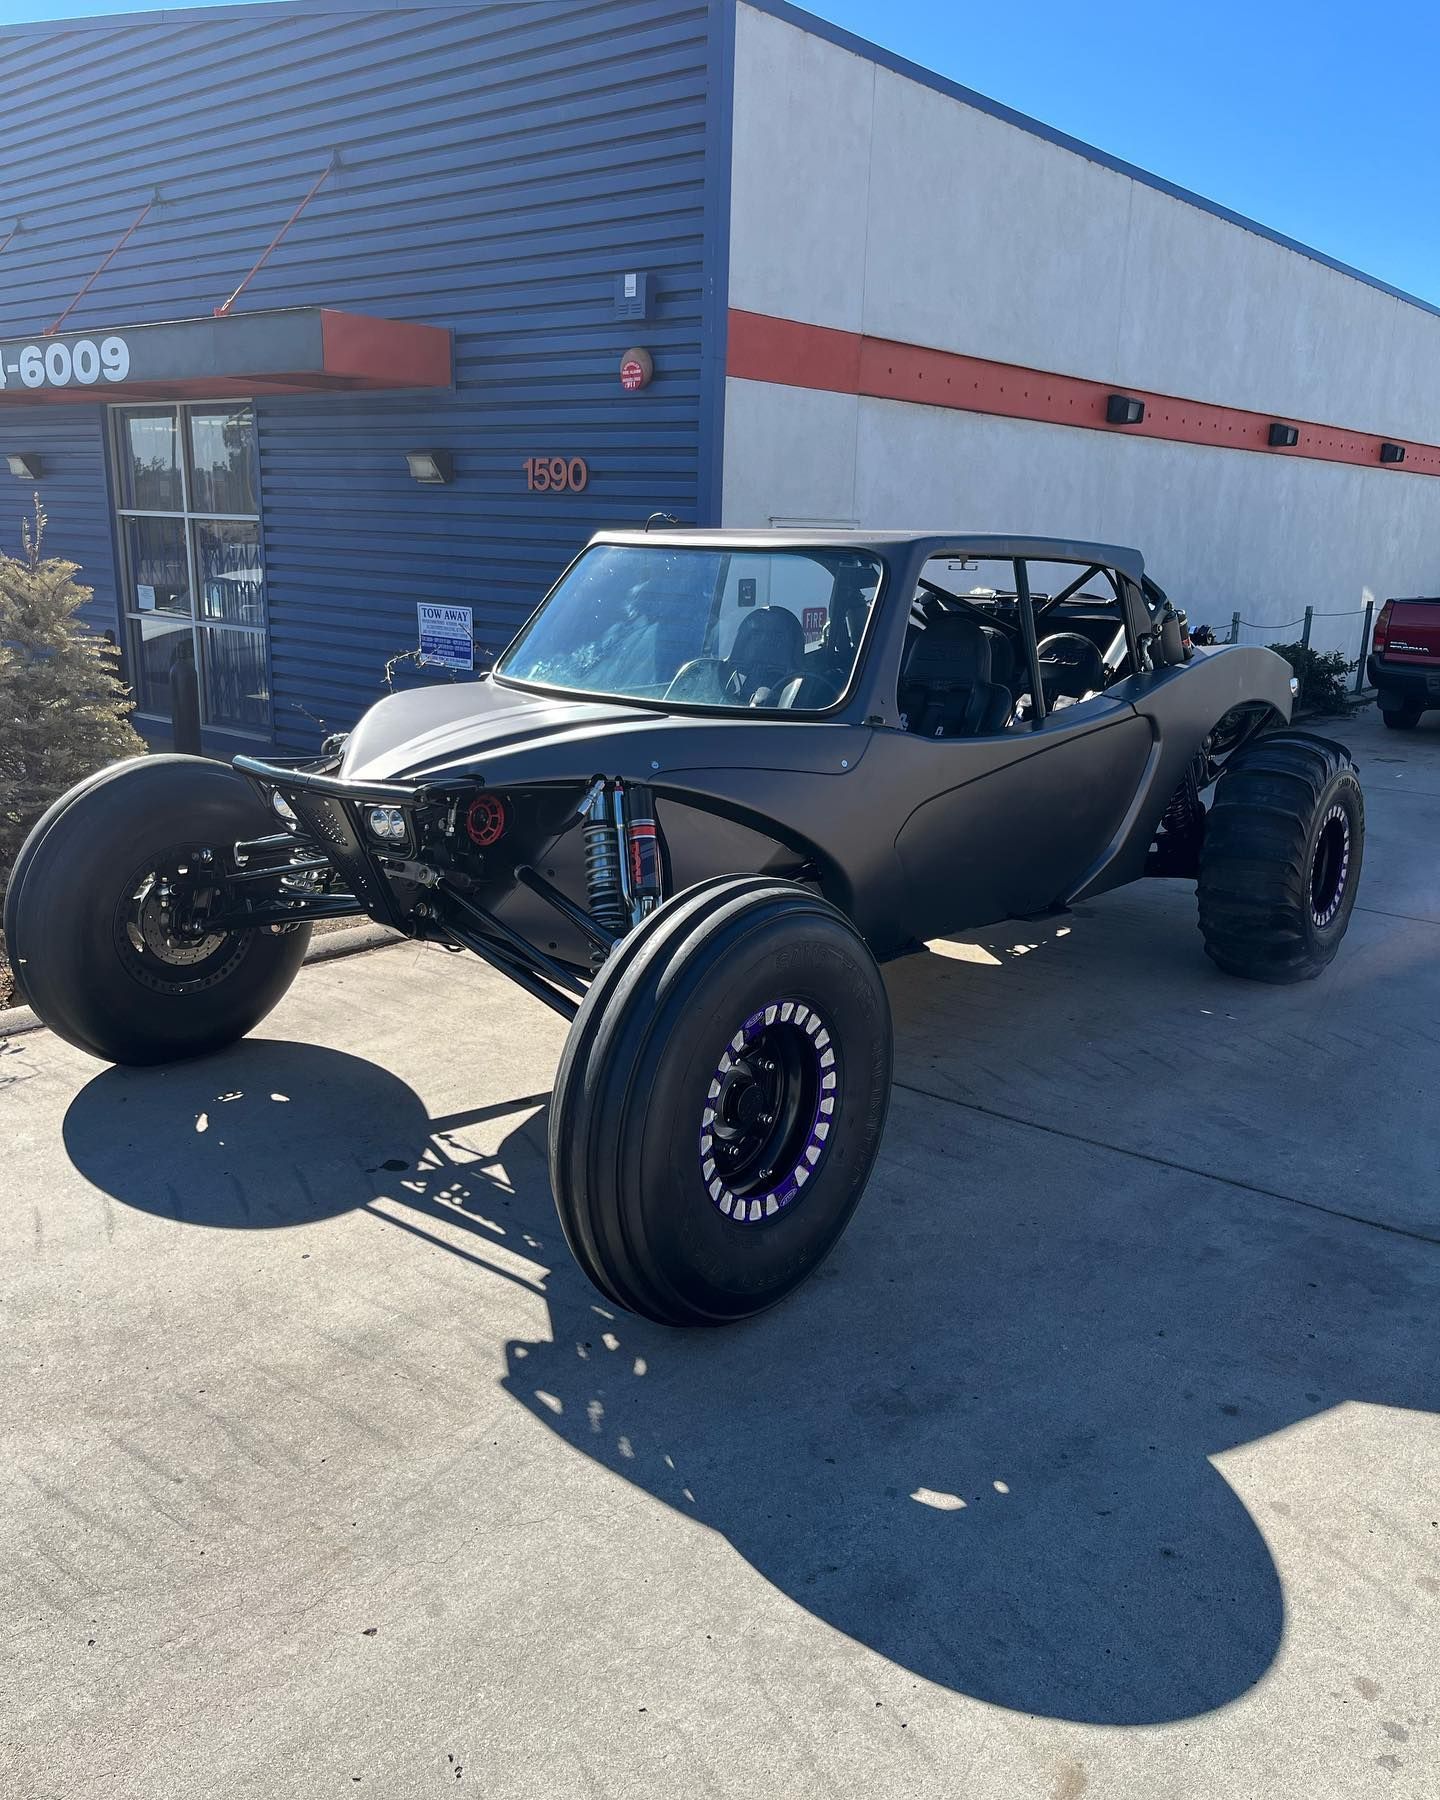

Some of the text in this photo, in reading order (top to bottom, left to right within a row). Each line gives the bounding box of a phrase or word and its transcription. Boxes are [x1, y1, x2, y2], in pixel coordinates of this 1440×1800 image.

[0, 336, 130, 389] -6009
[522, 457, 587, 492] 1590
[421, 608, 468, 621] TOW AWAY
[806, 612, 824, 629] FIRE
